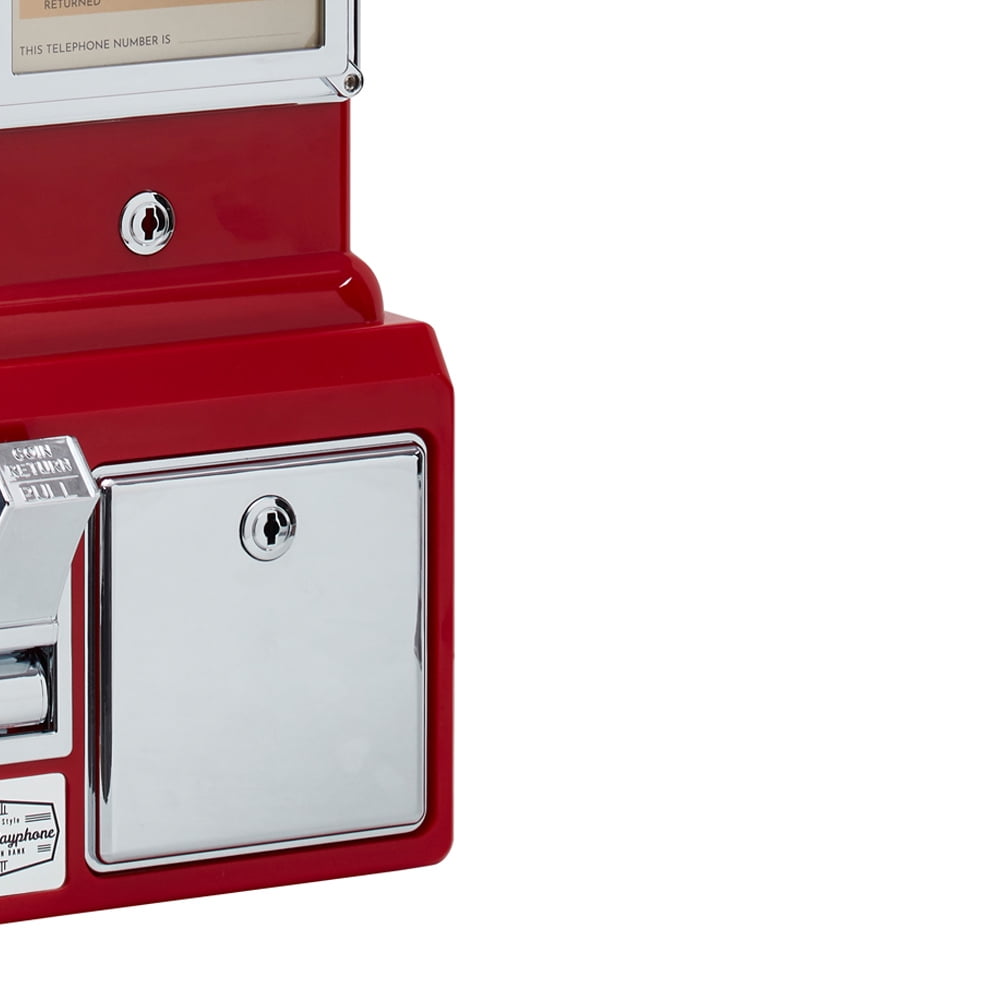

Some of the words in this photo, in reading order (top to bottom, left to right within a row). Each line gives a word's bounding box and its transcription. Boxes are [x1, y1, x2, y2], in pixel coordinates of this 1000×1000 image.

[20, 44, 43, 56] THIS
[46, 39, 110, 54] TELEPHONE
[114, 35, 158, 48] NUMBER
[162, 34, 171, 44] IS
[12, 444, 52, 461] COIN
[5, 458, 72, 479] RETURN
[2, 817, 20, 826] Style
